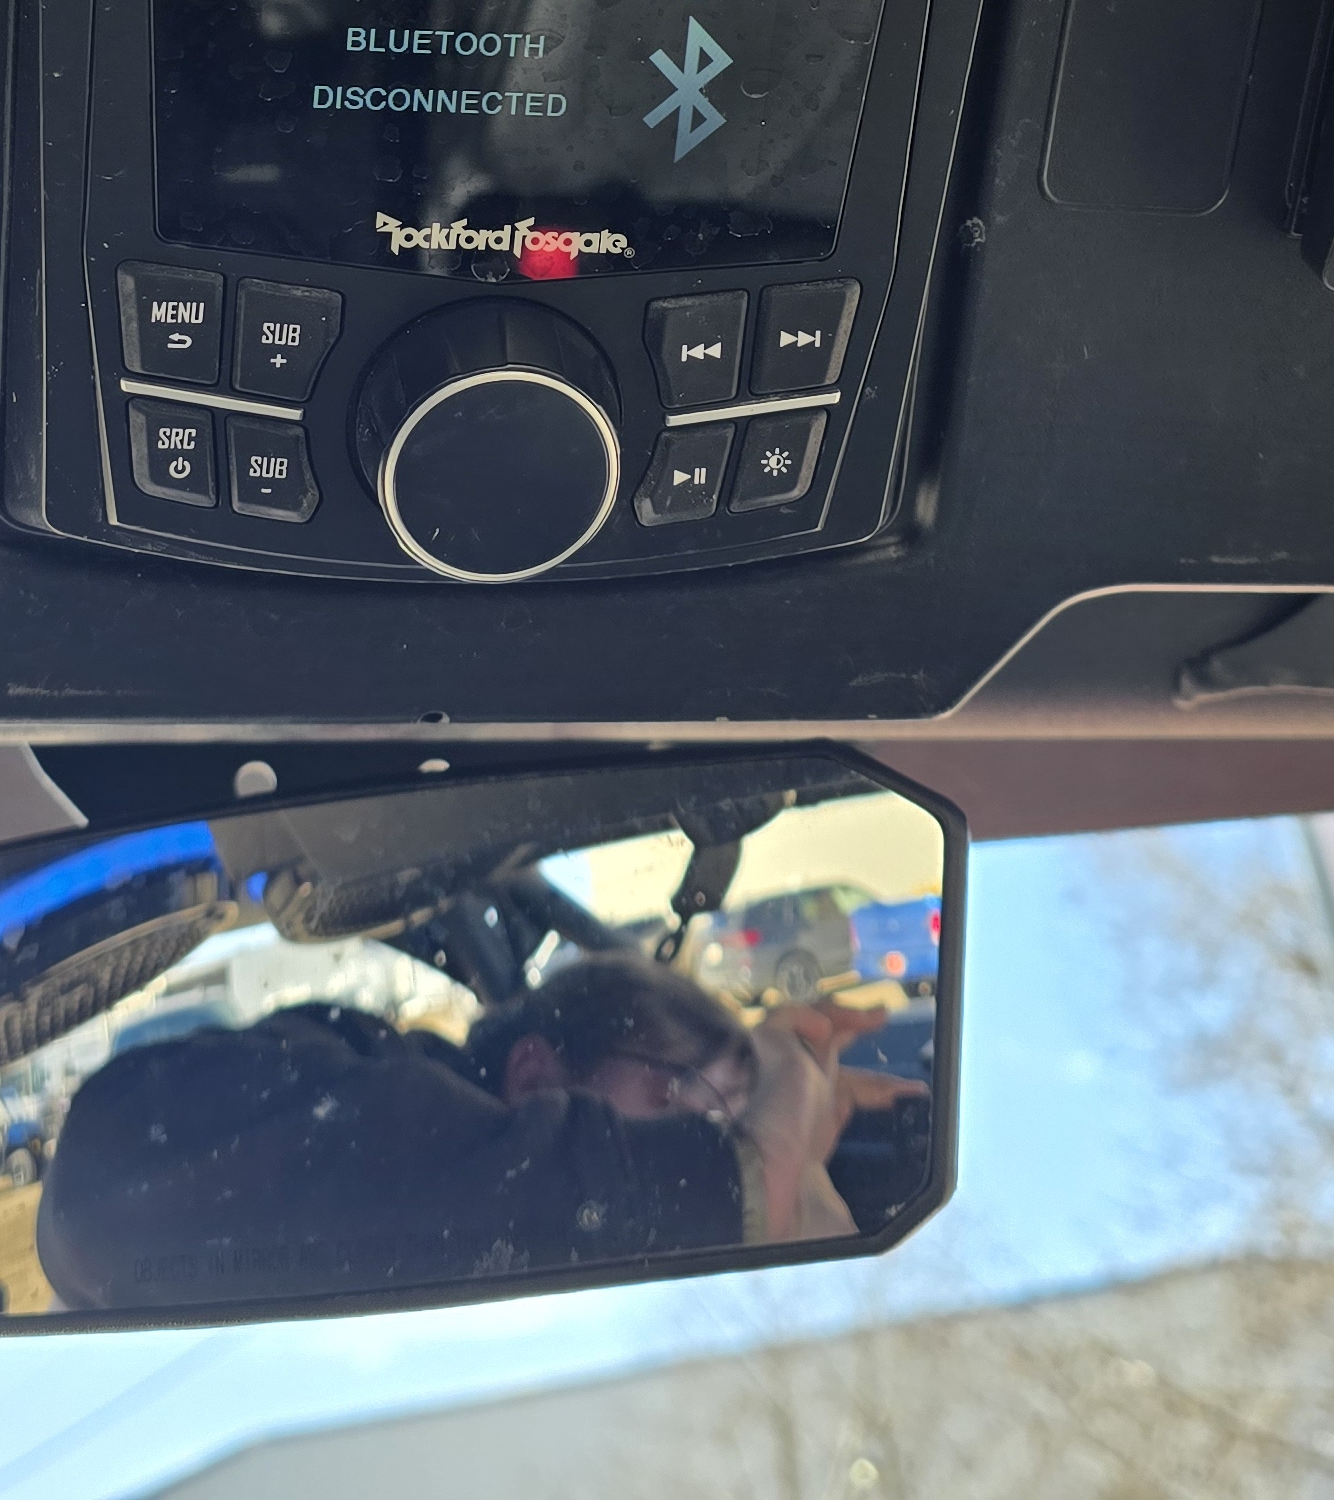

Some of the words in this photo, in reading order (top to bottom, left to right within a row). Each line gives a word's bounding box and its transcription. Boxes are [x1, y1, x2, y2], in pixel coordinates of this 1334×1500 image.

[346, 26, 546, 59] BLUETOOTH
[312, 85, 568, 118] DISCONNECTED
[375, 211, 512, 256] Rockford
[151, 301, 205, 324] MENU
[261, 322, 301, 346] SUB
[157, 427, 197, 450] SRC
[249, 455, 288, 479] SUB
